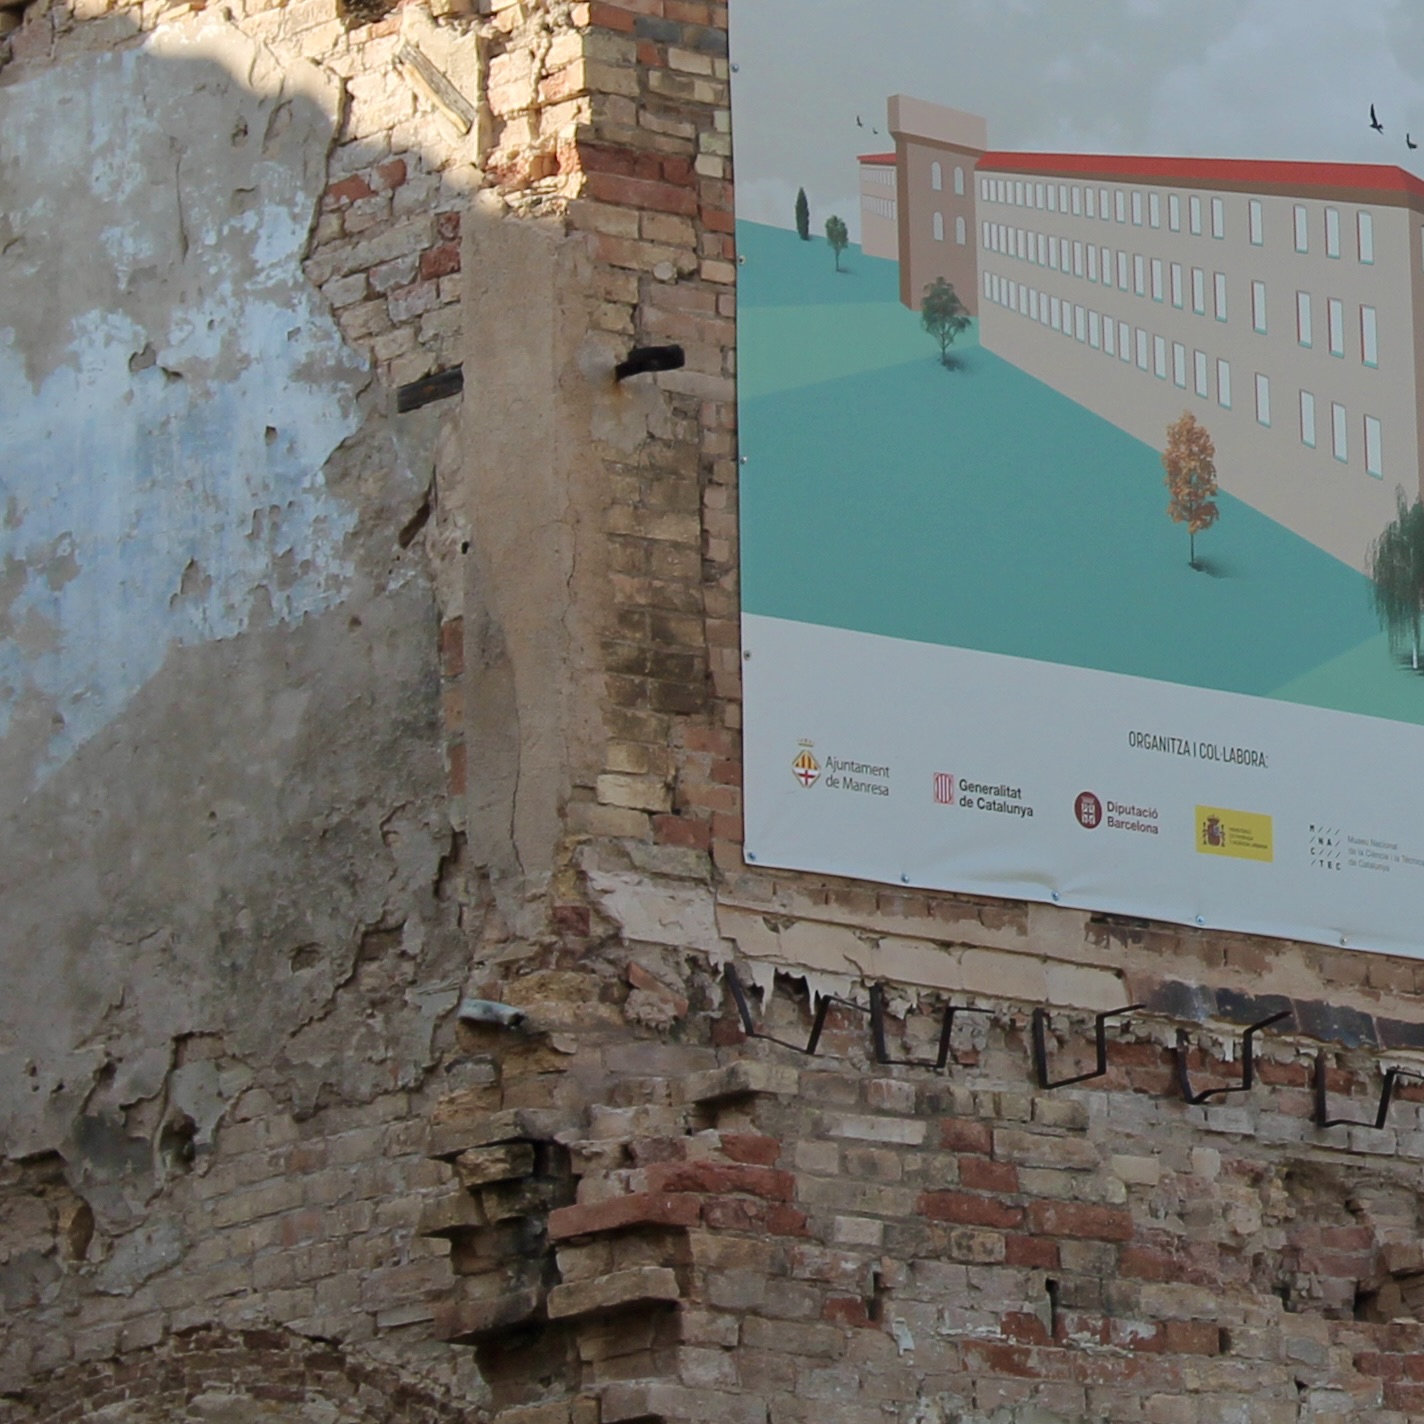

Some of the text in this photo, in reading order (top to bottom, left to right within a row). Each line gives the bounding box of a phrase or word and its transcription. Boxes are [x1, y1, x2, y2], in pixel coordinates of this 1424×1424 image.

[1128, 730, 1190, 757] ORGANITZA
[1193, 741, 1197, 758] I
[825, 755, 890, 778] Ajuntament
[825, 775, 889, 796] de Manresa
[959, 778, 1022, 799] Generalitat
[959, 795, 1034, 818] de Catalunya
[1106, 800, 1159, 819] Diputació
[1107, 815, 1159, 834] Barcelona
